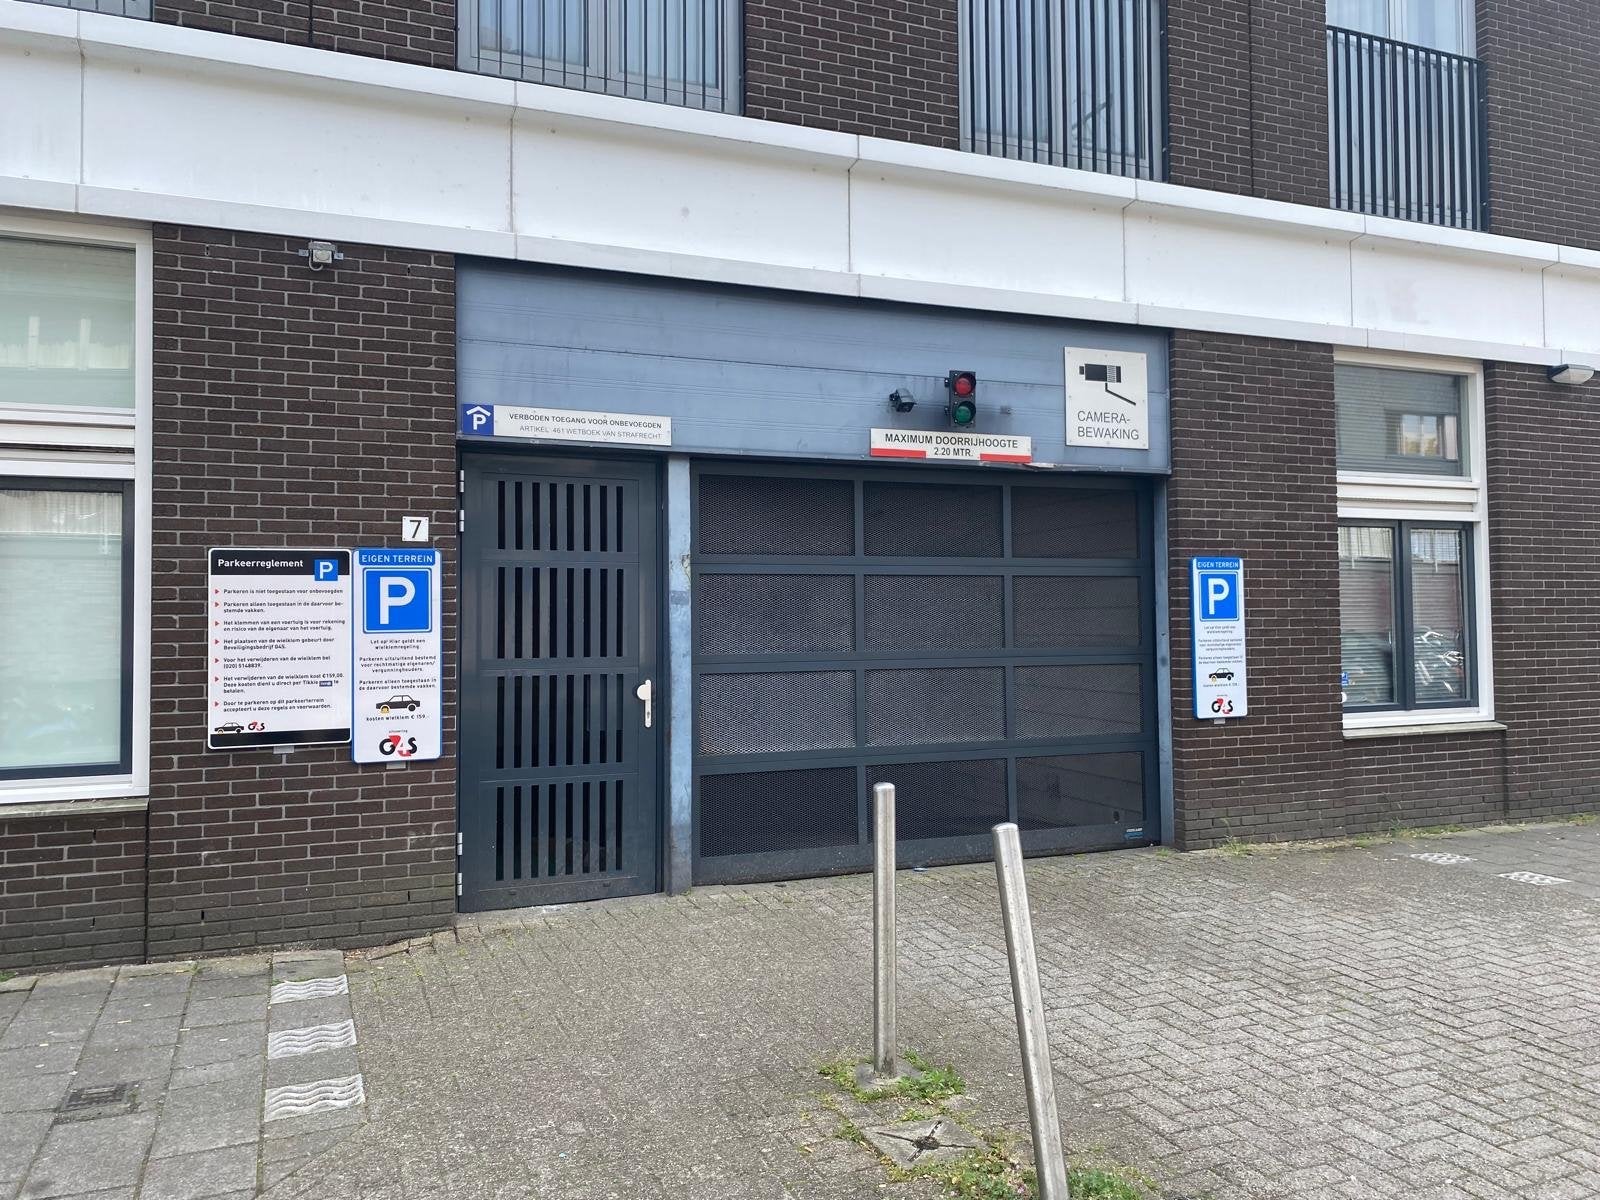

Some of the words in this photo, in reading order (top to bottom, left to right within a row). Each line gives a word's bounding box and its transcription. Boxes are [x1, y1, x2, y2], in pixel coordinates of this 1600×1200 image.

[474, 414, 486, 430] P
[509, 414, 549, 422] VERBODEN
[552, 416, 585, 425] TOEGANG
[610, 419, 661, 429] ONBEVOEGDEN
[1078, 411, 1130, 424] CAMERA-
[567, 428, 600, 436] WETBOEK
[617, 431, 661, 439] STRAFRECHT
[1078, 426, 1139, 440] BEWAKING
[885, 434, 933, 445] MAXIMUM
[935, 436, 1018, 449] DOORRIJHOOGTE
[934, 447, 950, 456] 2.20
[953, 448, 973, 457] MTR.
[410, 520, 422, 538] 7
[218, 559, 303, 568] Parkeerreglement
[320, 562, 333, 579] P
[380, 577, 415, 624] P
[1208, 578, 1229, 614] P
[379, 735, 417, 756] G4S
